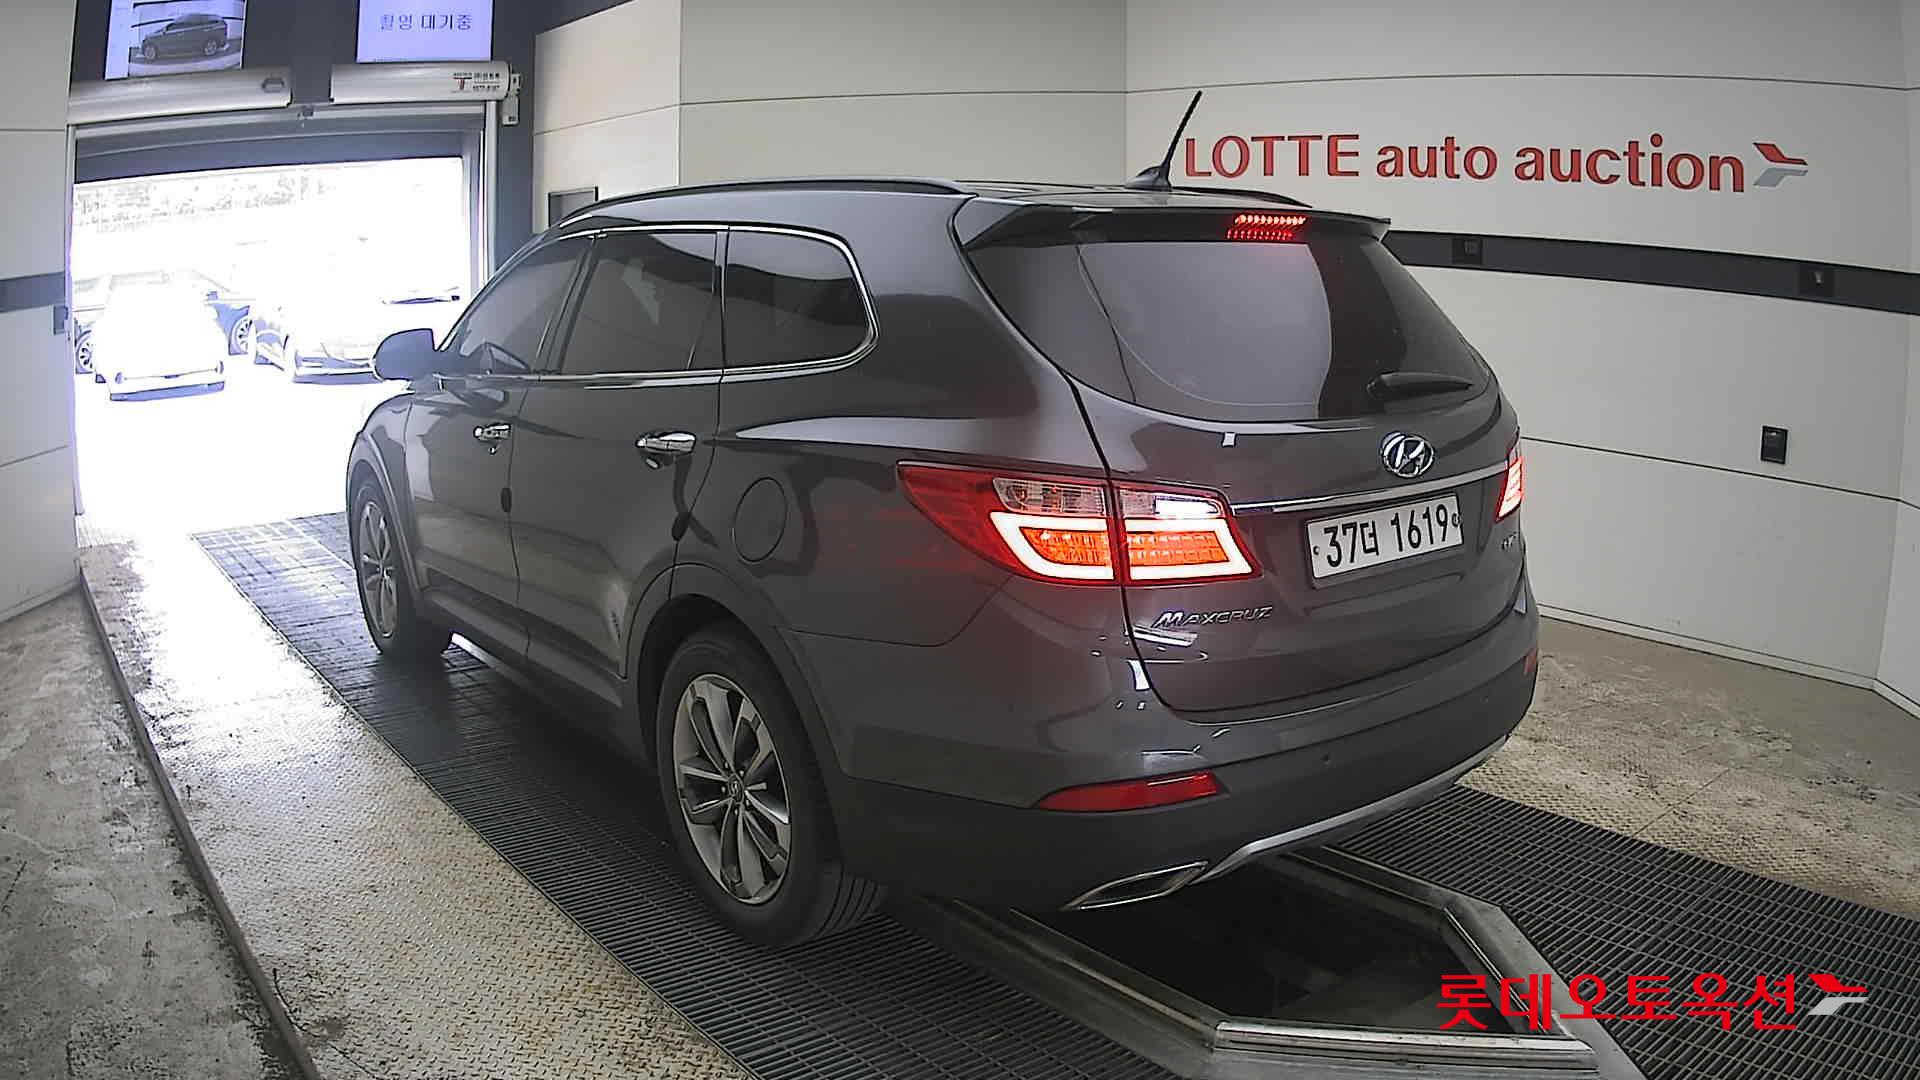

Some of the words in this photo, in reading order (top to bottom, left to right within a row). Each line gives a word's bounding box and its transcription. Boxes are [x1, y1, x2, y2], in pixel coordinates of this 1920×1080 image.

[420, 14, 472, 31] 대기중
[1184, 134, 1361, 178] LOTTE
[1377, 137, 1498, 179] auto
[1514, 134, 1745, 191] auction
[1323, 520, 1380, 568] 37더
[1390, 503, 1449, 552] 1619
[1151, 604, 1274, 629] MAXCRUZ
